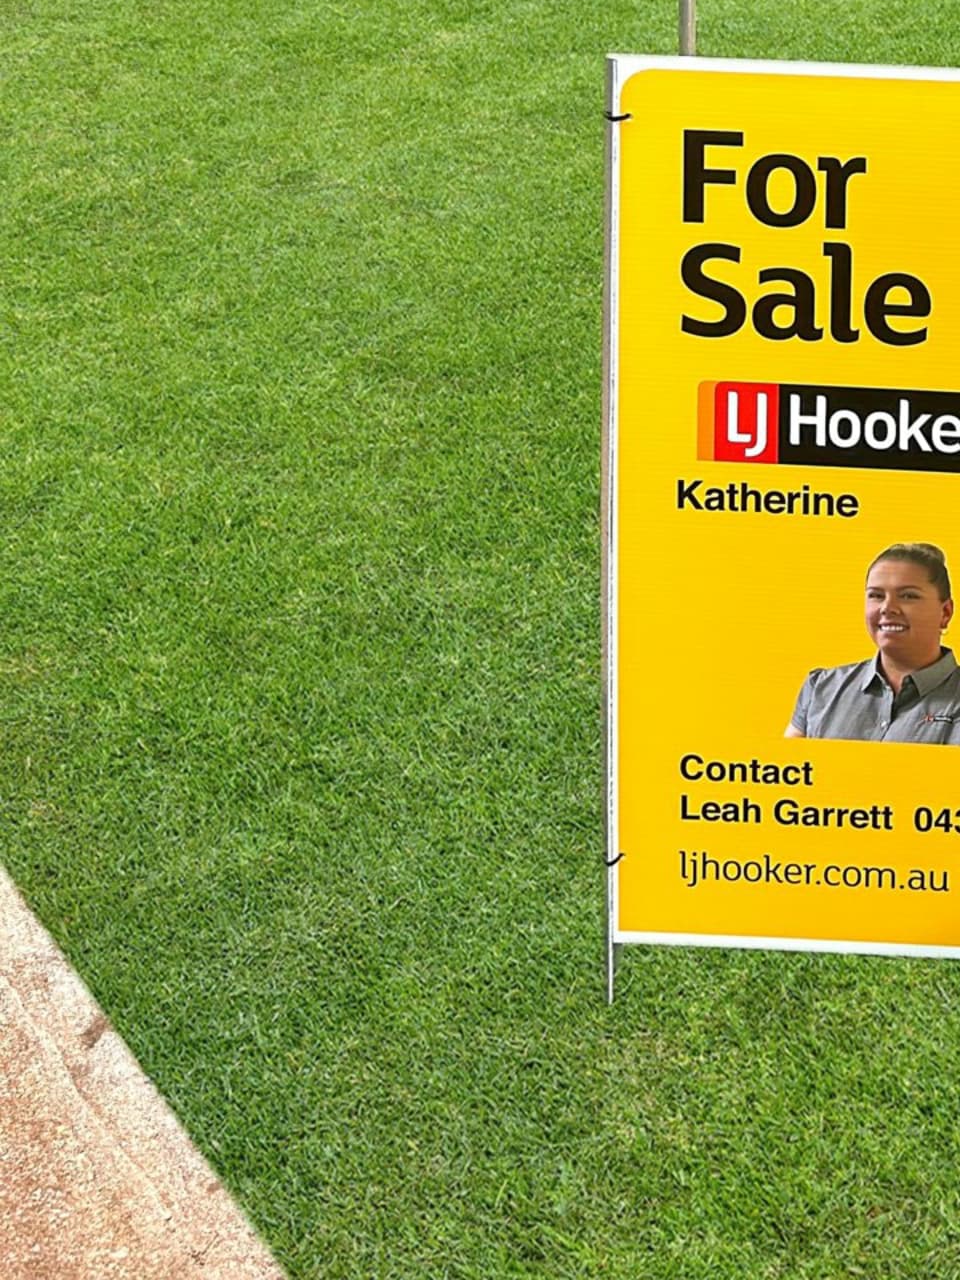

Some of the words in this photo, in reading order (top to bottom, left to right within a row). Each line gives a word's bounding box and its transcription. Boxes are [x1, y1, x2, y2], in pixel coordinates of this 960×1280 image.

[682, 129, 867, 230] For
[680, 242, 932, 347] Sale
[727, 391, 768, 457] LJ
[677, 479, 859, 518] Katherine
[680, 754, 813, 786] Contact
[680, 794, 761, 824] Leah
[774, 799, 894, 830] Garrett
[679, 850, 949, 892] ljhooker.com.au
